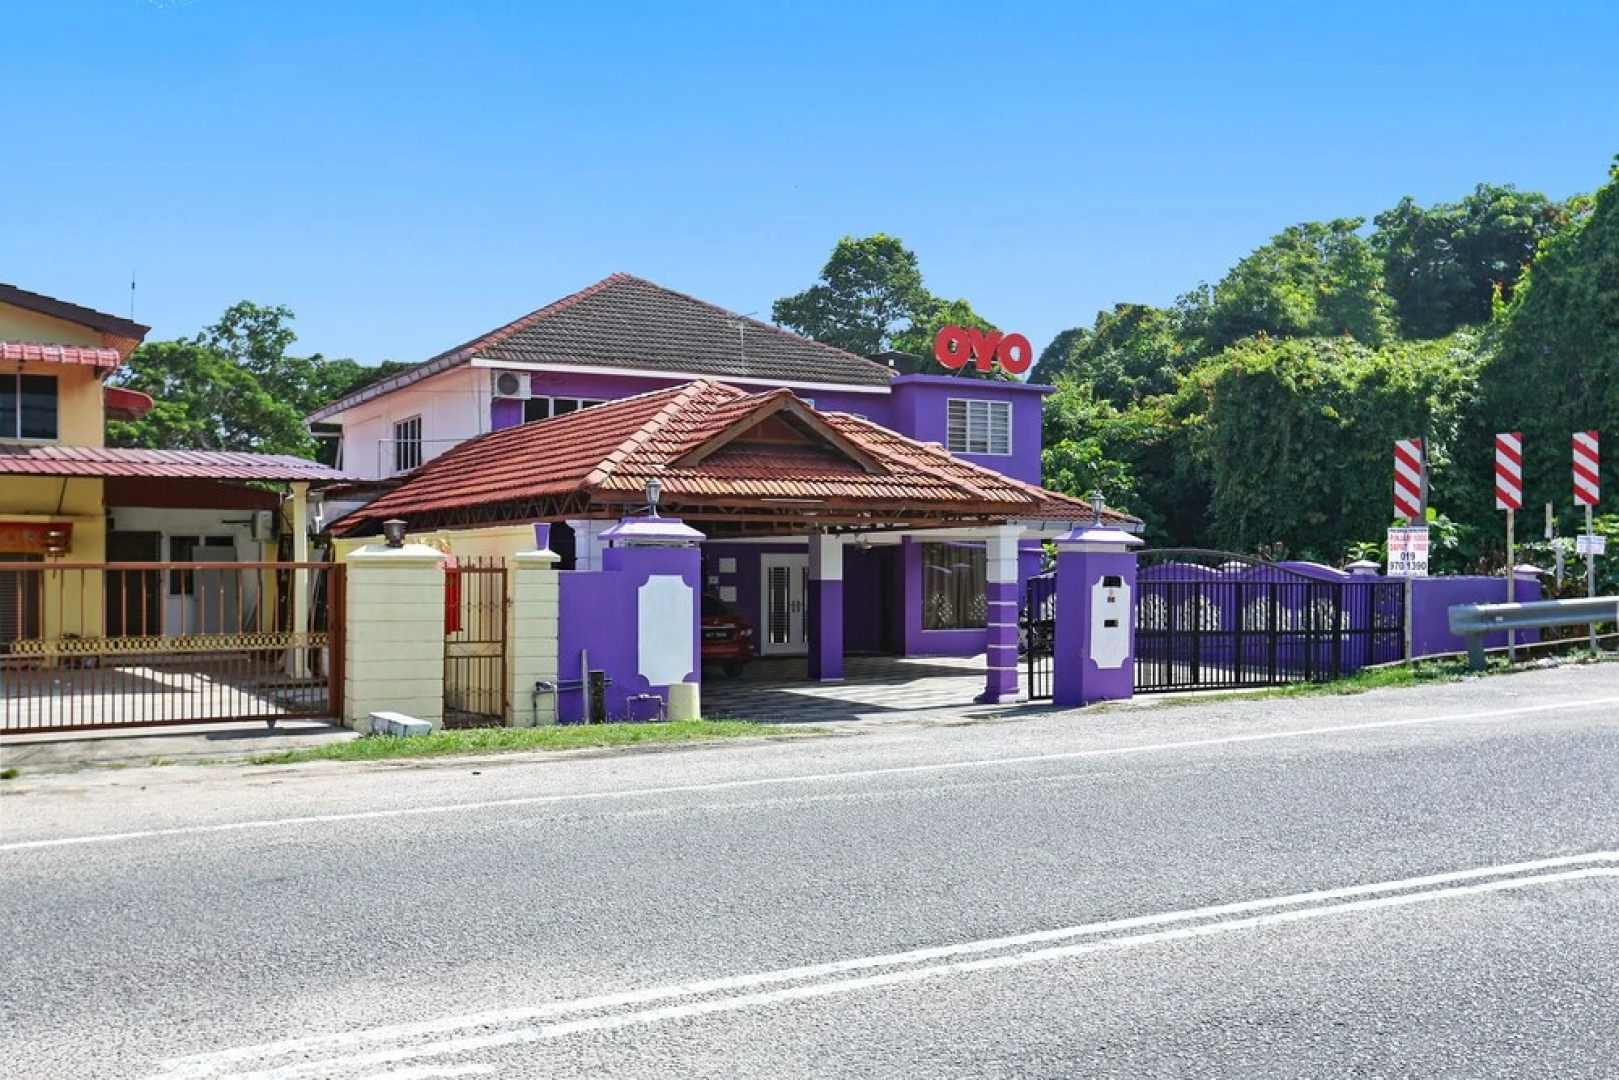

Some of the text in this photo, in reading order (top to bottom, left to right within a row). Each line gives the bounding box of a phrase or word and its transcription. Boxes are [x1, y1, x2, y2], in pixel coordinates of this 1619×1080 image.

[934, 325, 1033, 374] OYO
[1400, 552, 1415, 560] 019
[1389, 562, 1404, 570] 970
